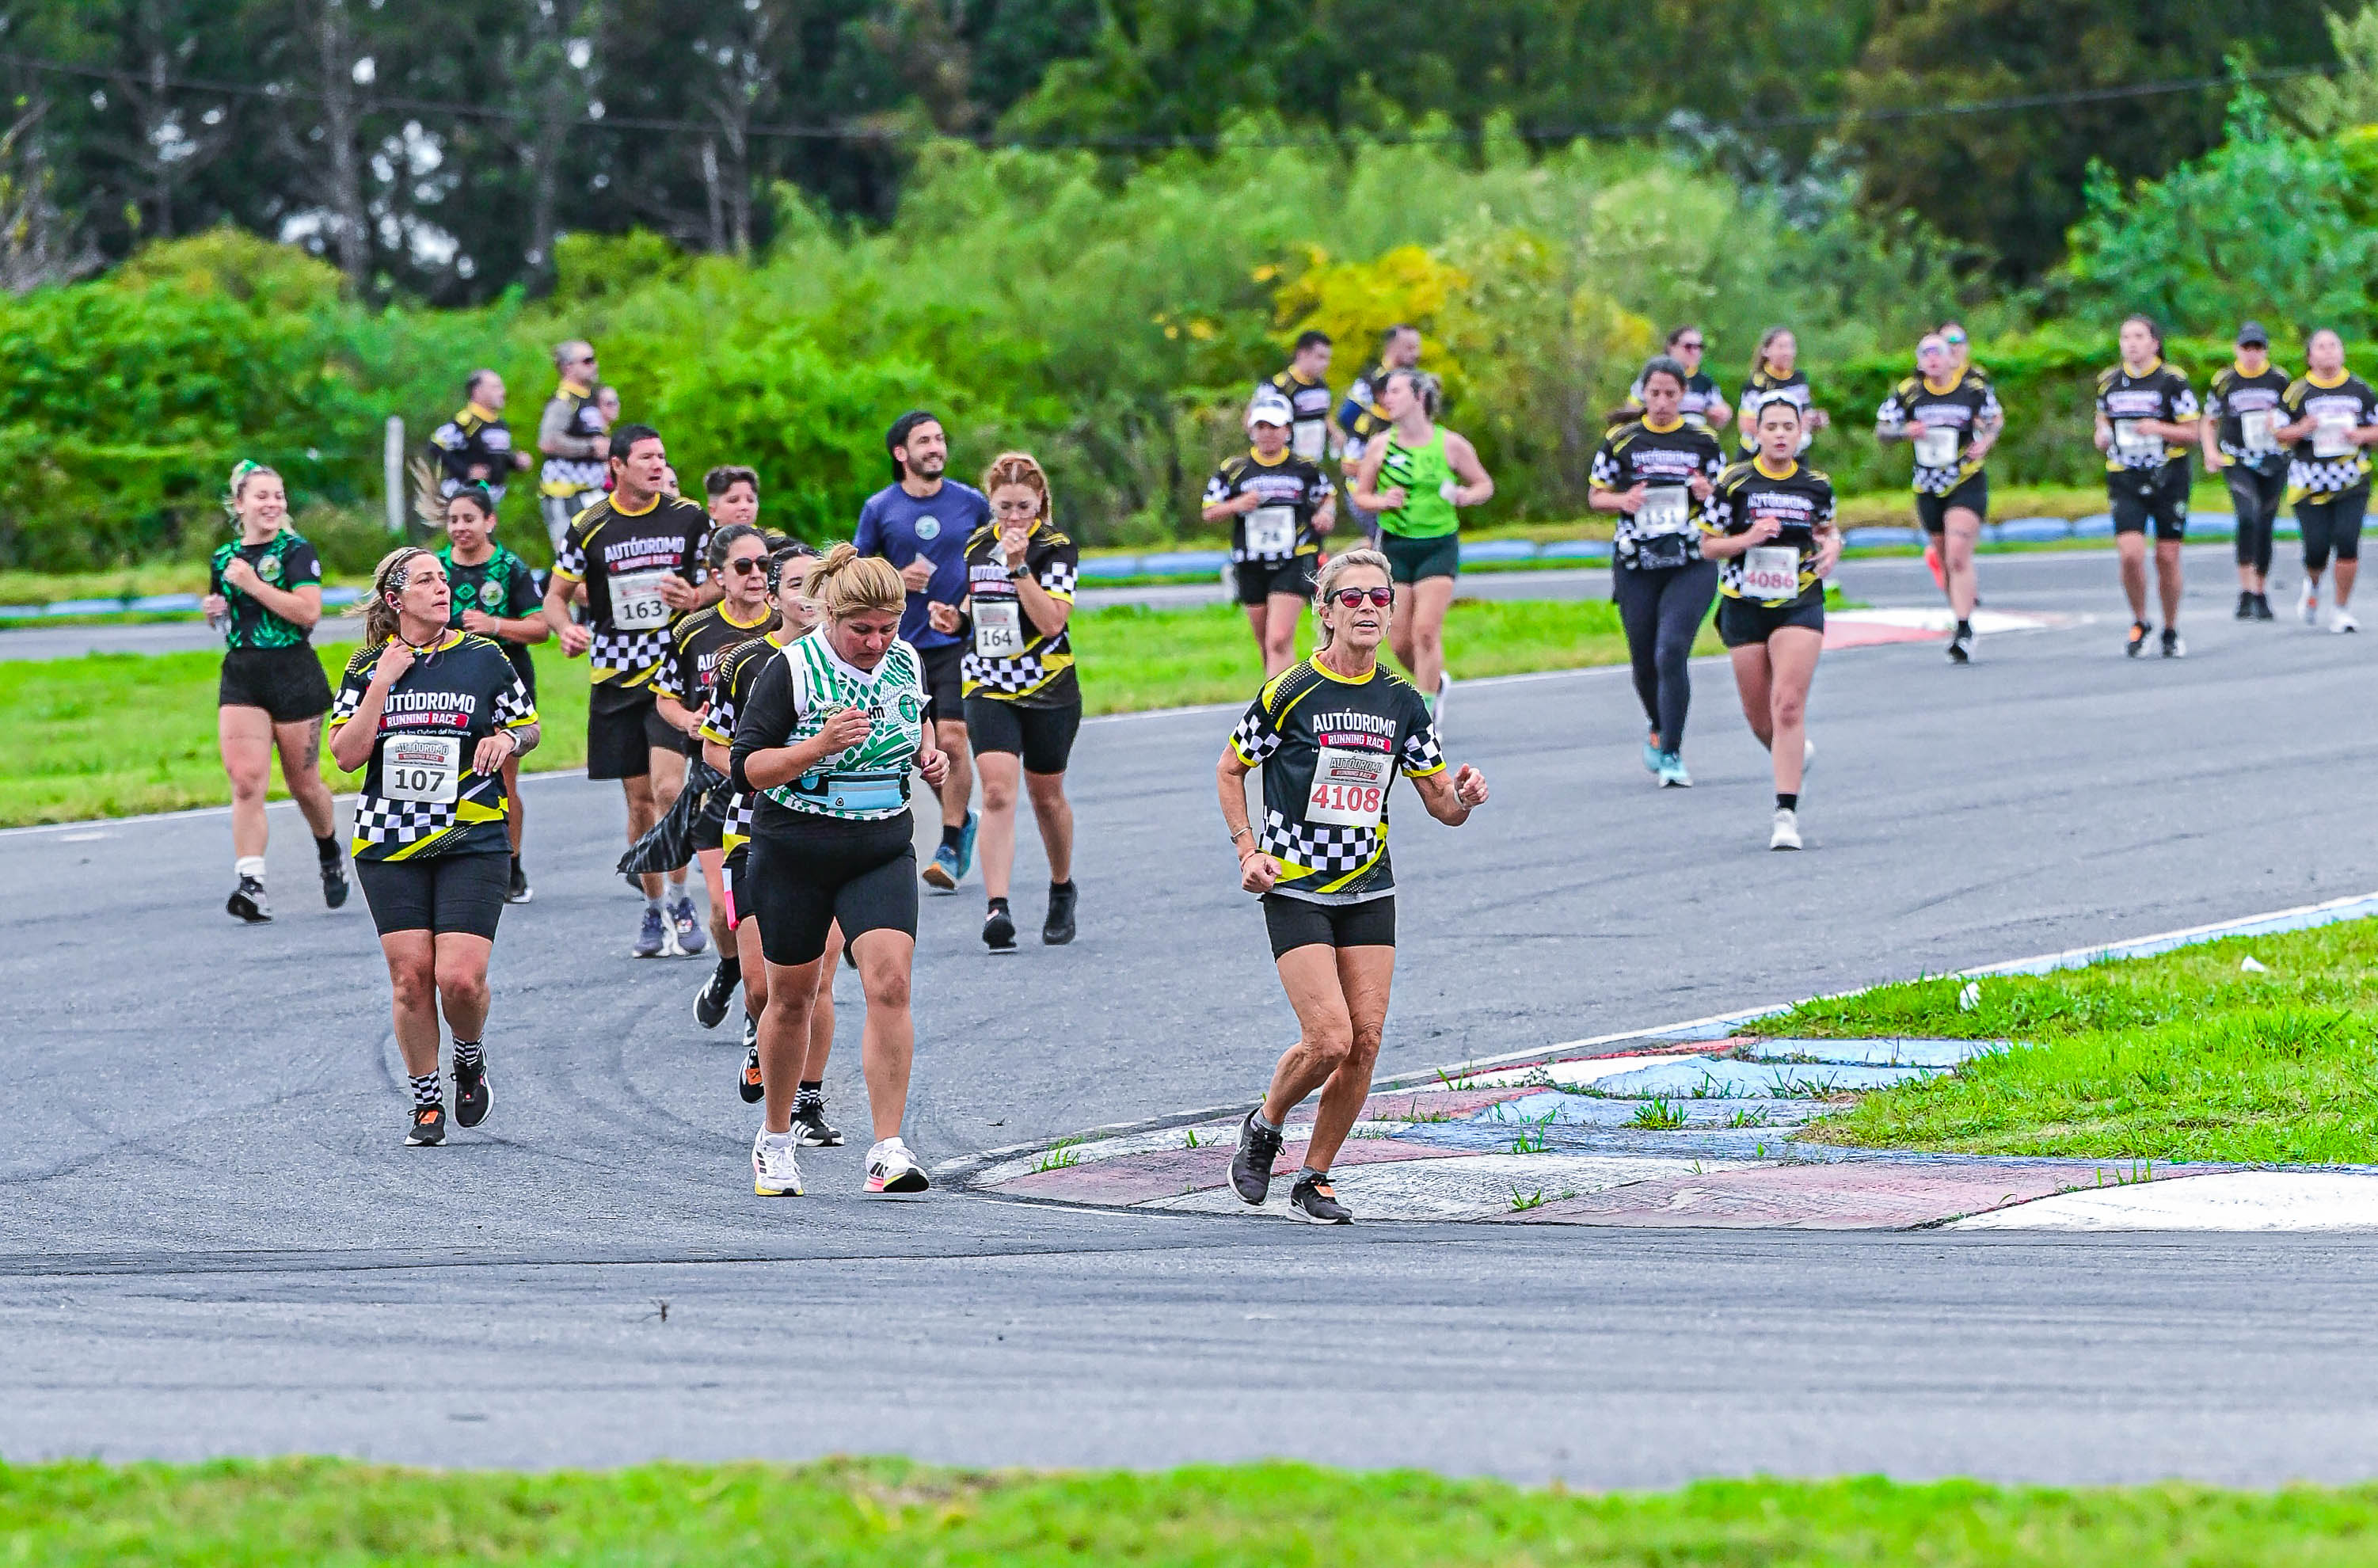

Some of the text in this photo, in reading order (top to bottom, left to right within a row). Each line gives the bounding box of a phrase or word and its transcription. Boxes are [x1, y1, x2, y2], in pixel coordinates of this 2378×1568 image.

[604, 536, 685, 562] AUTÓDROMO
[1746, 570, 1794, 589] 4086
[623, 600, 663, 620] 163
[983, 629, 1013, 647] 164
[382, 688, 476, 714] UTÓDROMO
[386, 713, 458, 727] RUNNING RACE
[1312, 707, 1397, 738] AUTÓDROMO
[395, 740, 450, 755] AUTÓDROMO
[1328, 733, 1386, 750] RUNNING RACE
[1330, 756, 1384, 773] AUTÓDROMO
[394, 769, 445, 792] 107
[1311, 785, 1380, 813] 4108
